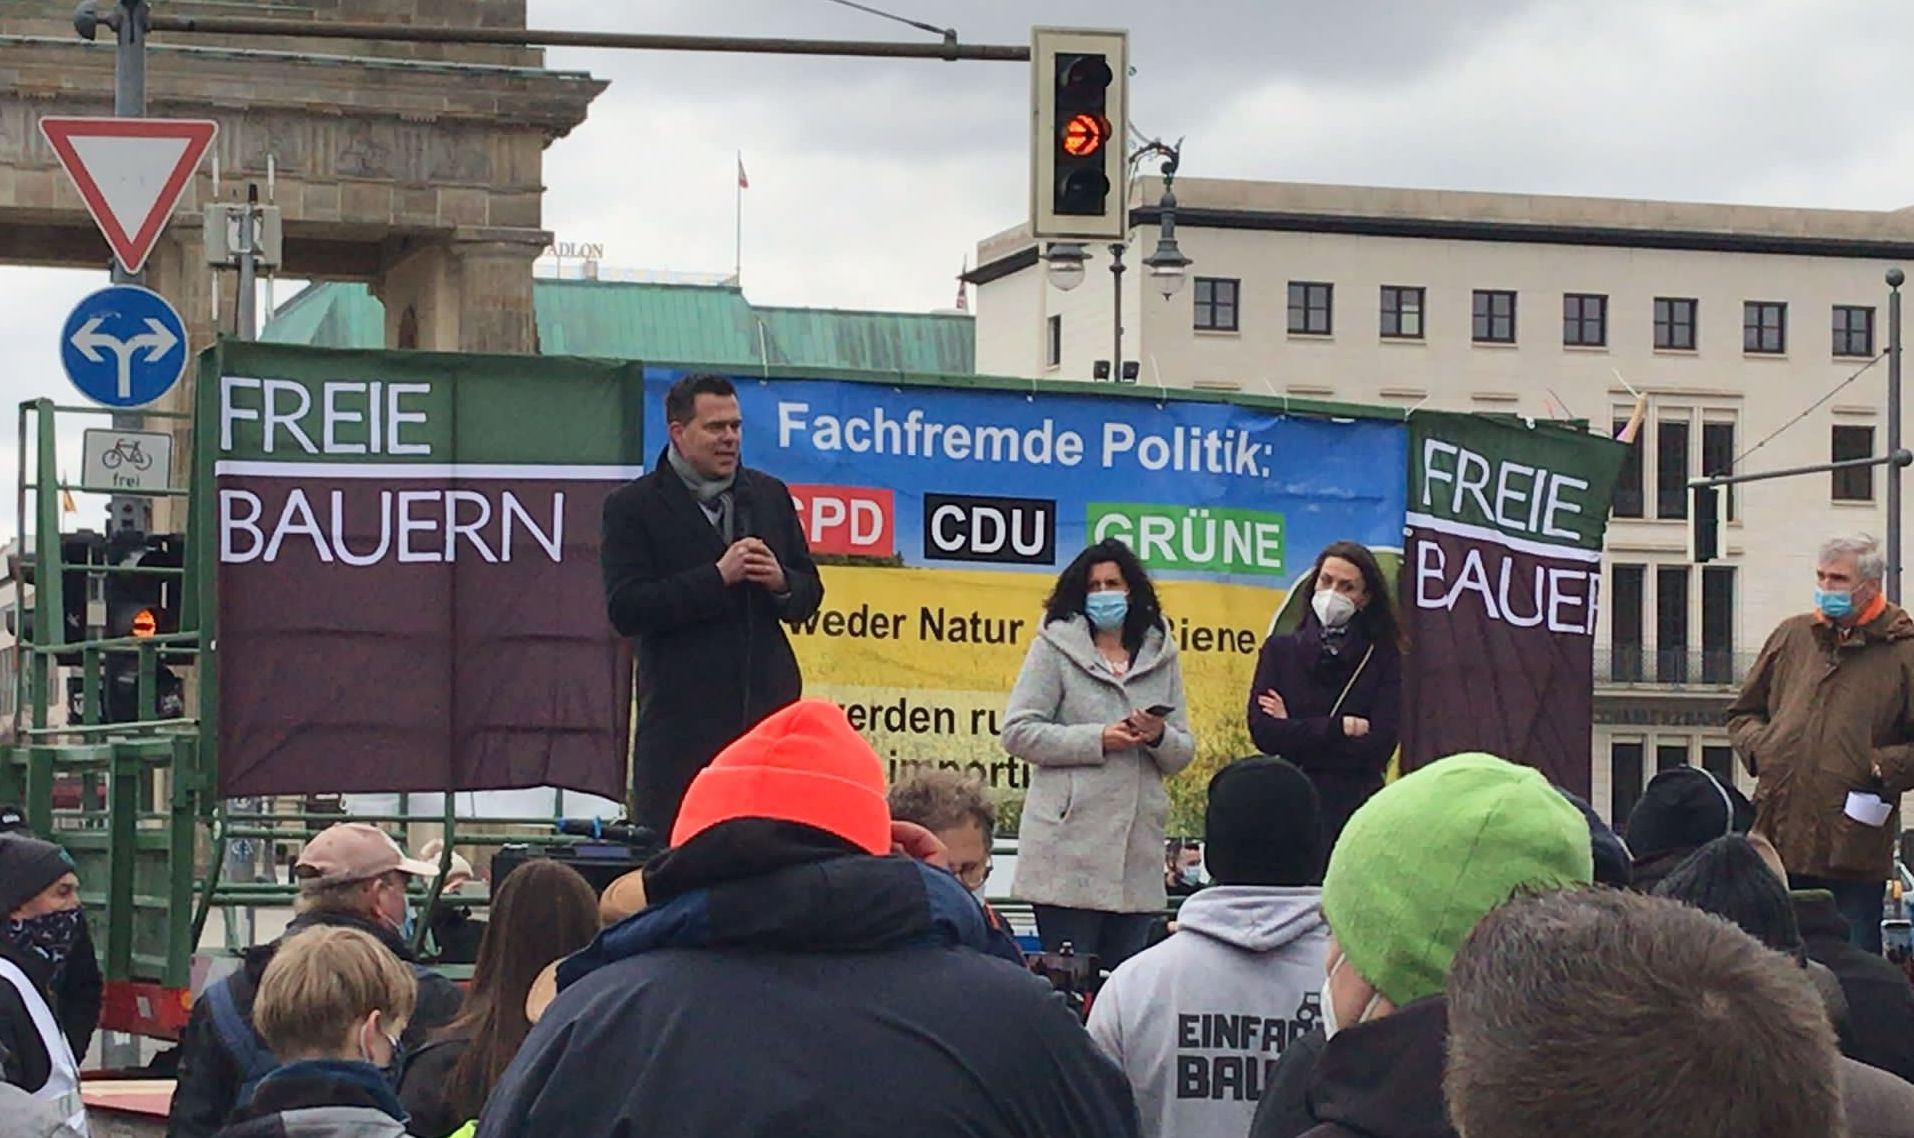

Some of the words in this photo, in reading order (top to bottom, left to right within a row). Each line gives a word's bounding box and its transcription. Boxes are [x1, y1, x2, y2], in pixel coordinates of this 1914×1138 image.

[547, 242, 604, 259] ADLON
[220, 376, 431, 454] FREIE
[778, 402, 1084, 466] Fachfremde
[1102, 422, 1272, 478] Politik:
[113, 472, 140, 488] frei
[1423, 438, 1588, 540] FREIE
[219, 488, 564, 566] BAUERN
[930, 504, 1046, 556] CDU
[1094, 508, 1281, 568] GRÜNE
[919, 606, 1025, 645] Natur
[1167, 617, 1256, 654] iene
[838, 697, 956, 734] erden
